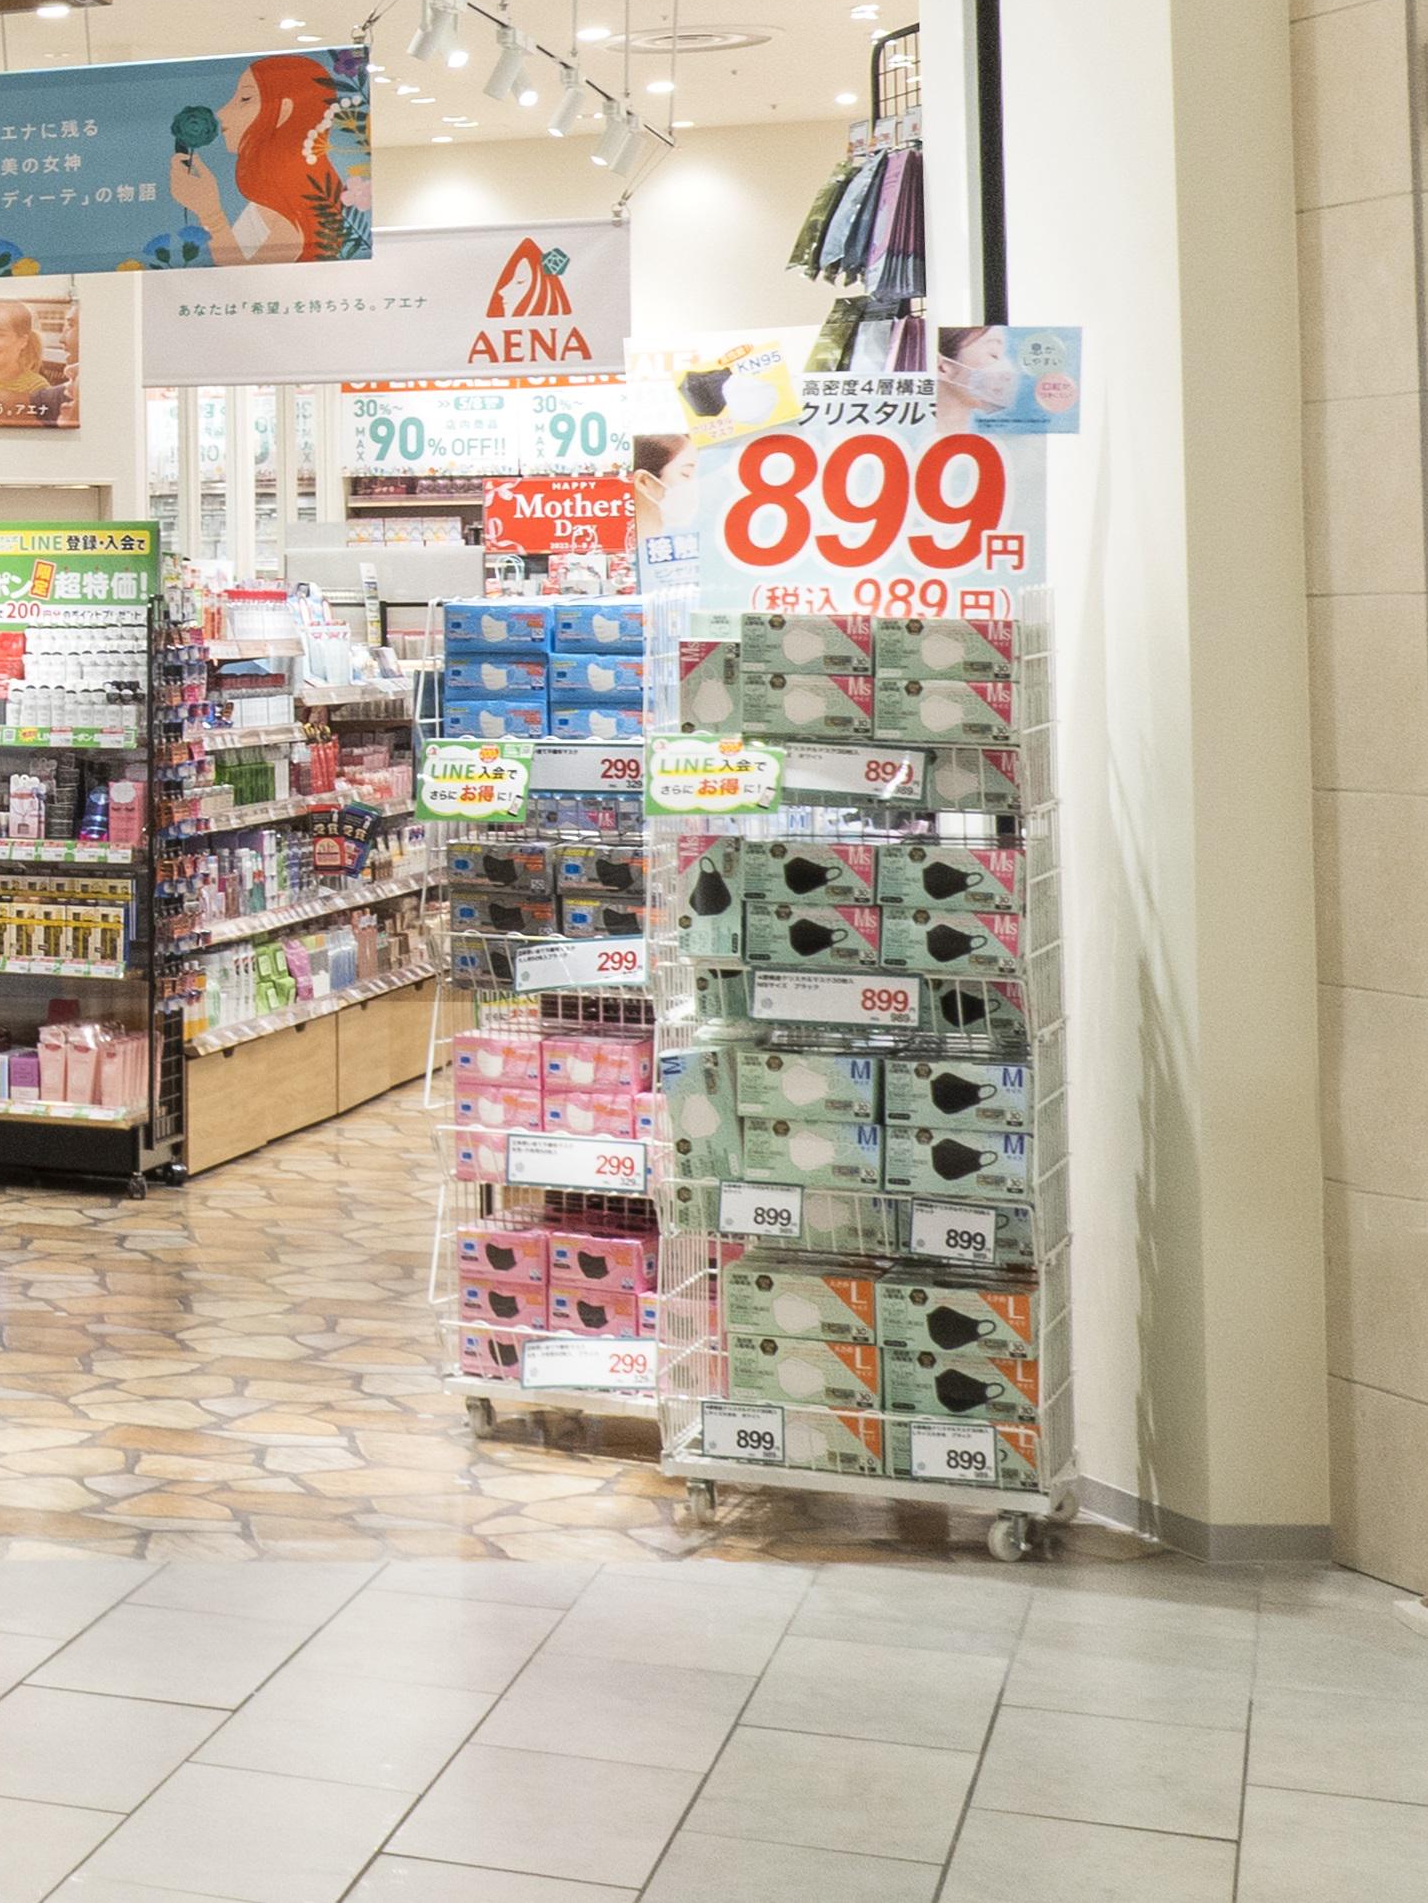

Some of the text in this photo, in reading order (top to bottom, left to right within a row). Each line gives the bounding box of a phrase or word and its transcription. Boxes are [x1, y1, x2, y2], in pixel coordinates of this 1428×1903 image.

[0, 153, 83, 176] 美の女神
[467, 325, 594, 364] AENA
[736, 350, 782, 373] KN95
[801, 378, 934, 397] 高密度4層構造
[450, 437, 507, 458] OFF!!
[552, 481, 596, 491] HAPPY
[513, 492, 635, 520] Mother's
[600, 758, 642, 780] 299
[864, 759, 914, 785] 899
[989, 851, 1014, 873] Ms
[597, 950, 637, 972] 299
[860, 988, 908, 1012] 899
[850, 1060, 871, 1080] M
[1002, 1068, 1024, 1088] M
[857, 1124, 878, 1146] M
[1003, 1134, 1025, 1155] M
[595, 1154, 636, 1177] 299
[753, 1206, 792, 1227] 899
[946, 1229, 986, 1250] 899
[851, 1281, 868, 1305] L
[1008, 1296, 1025, 1319] L
[609, 1353, 648, 1374] 299
[855, 1346, 872, 1370] L
[736, 1429, 775, 1450] 899
[946, 1449, 987, 1471] 899
